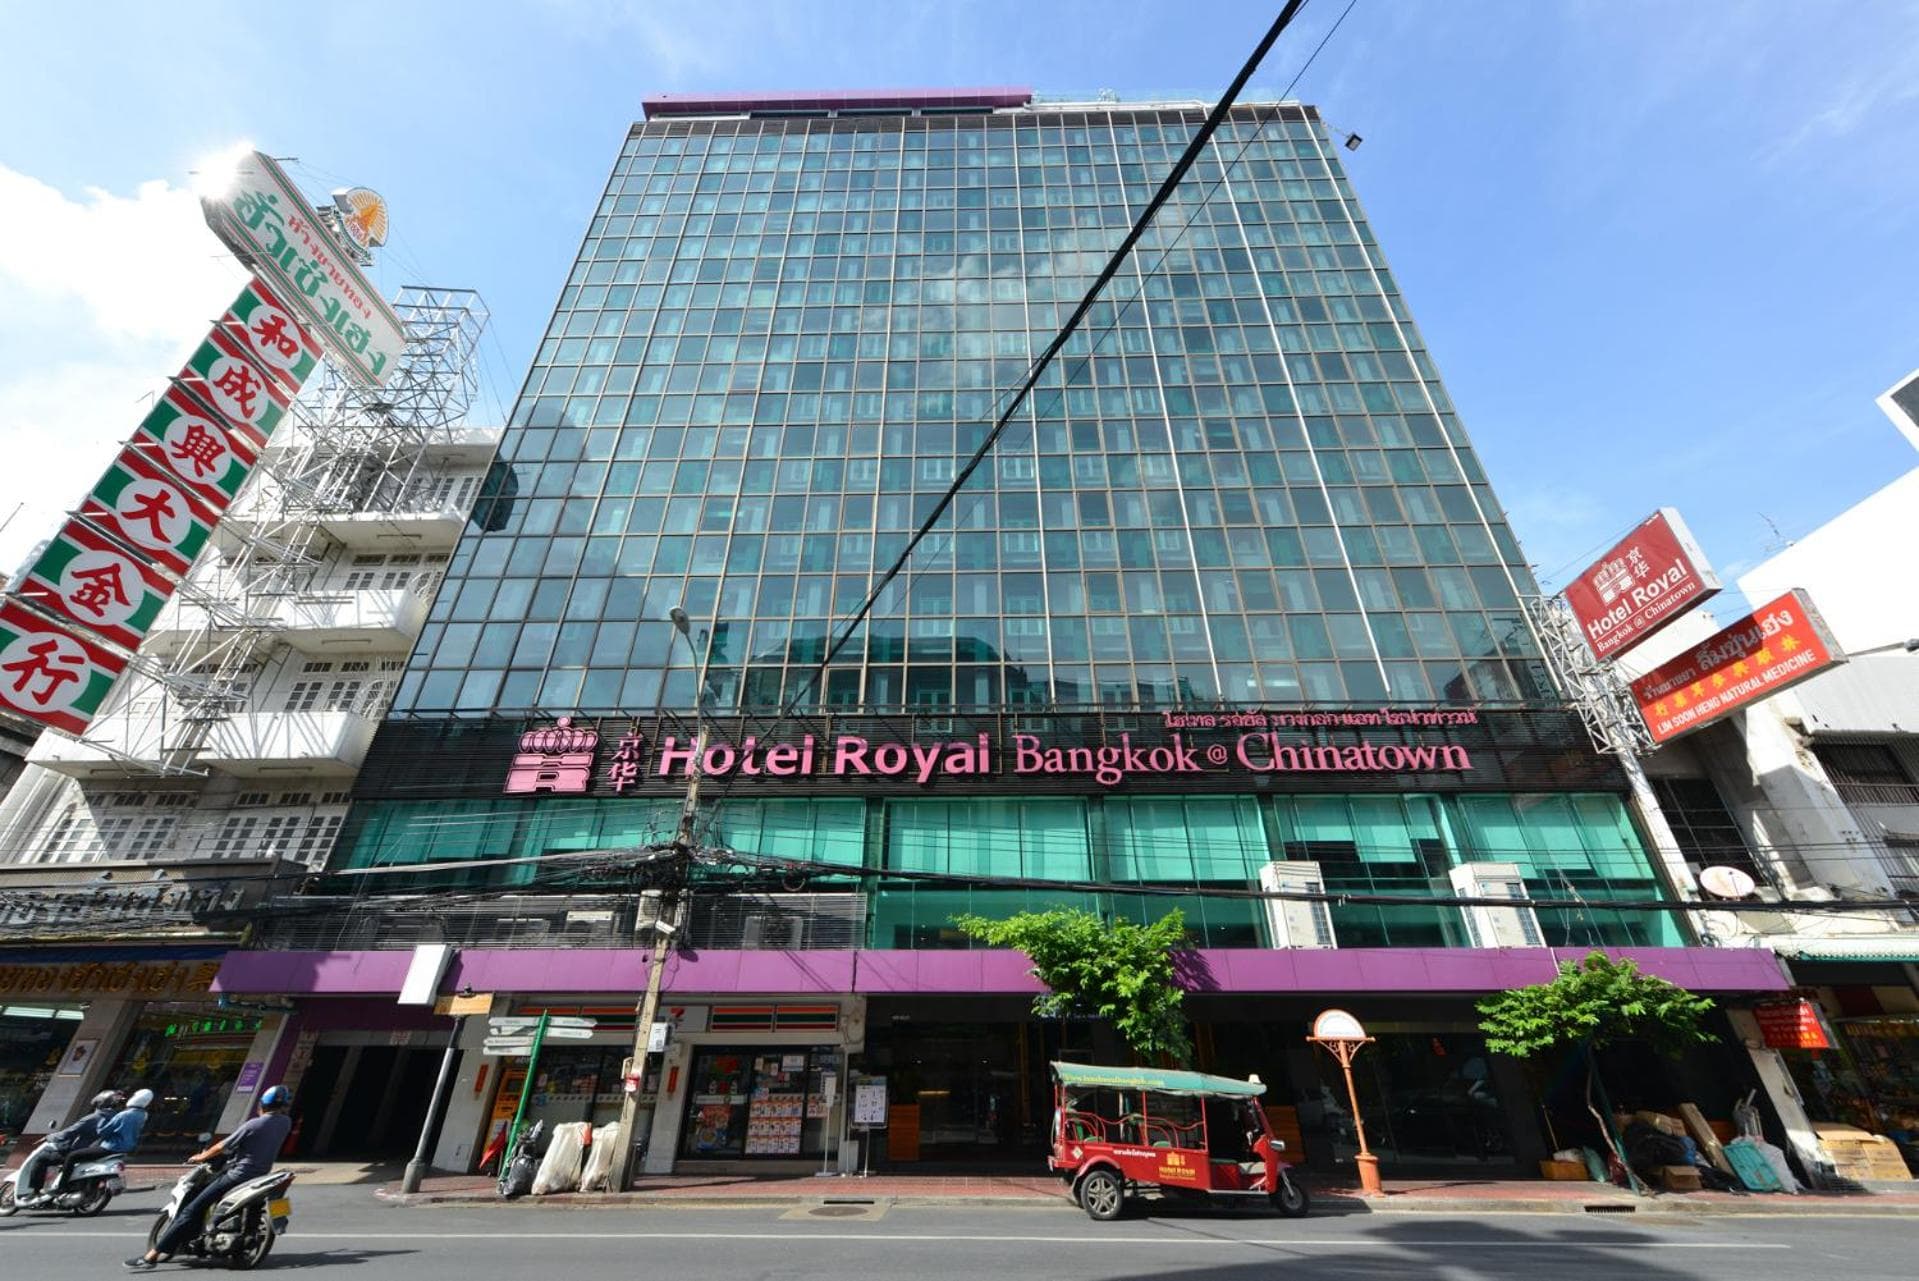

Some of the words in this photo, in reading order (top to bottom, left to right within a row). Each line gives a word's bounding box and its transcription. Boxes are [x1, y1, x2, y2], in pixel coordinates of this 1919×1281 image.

[1587, 598, 1632, 641] Hotel
[1632, 558, 1688, 608] Royal
[1596, 623, 1634, 653] Bangkok
[1645, 582, 1697, 621] Chinatown
[1672, 709, 1698, 732] SOON
[1719, 676, 1764, 705] NATURAL
[1762, 649, 1817, 685] MEDICINE
[658, 733, 816, 777] Hotel
[834, 731, 991, 784] Royal
[1014, 733, 1200, 786] Bangkok
[1207, 744, 1229, 765] @
[1237, 731, 1474, 773] Chinatown
